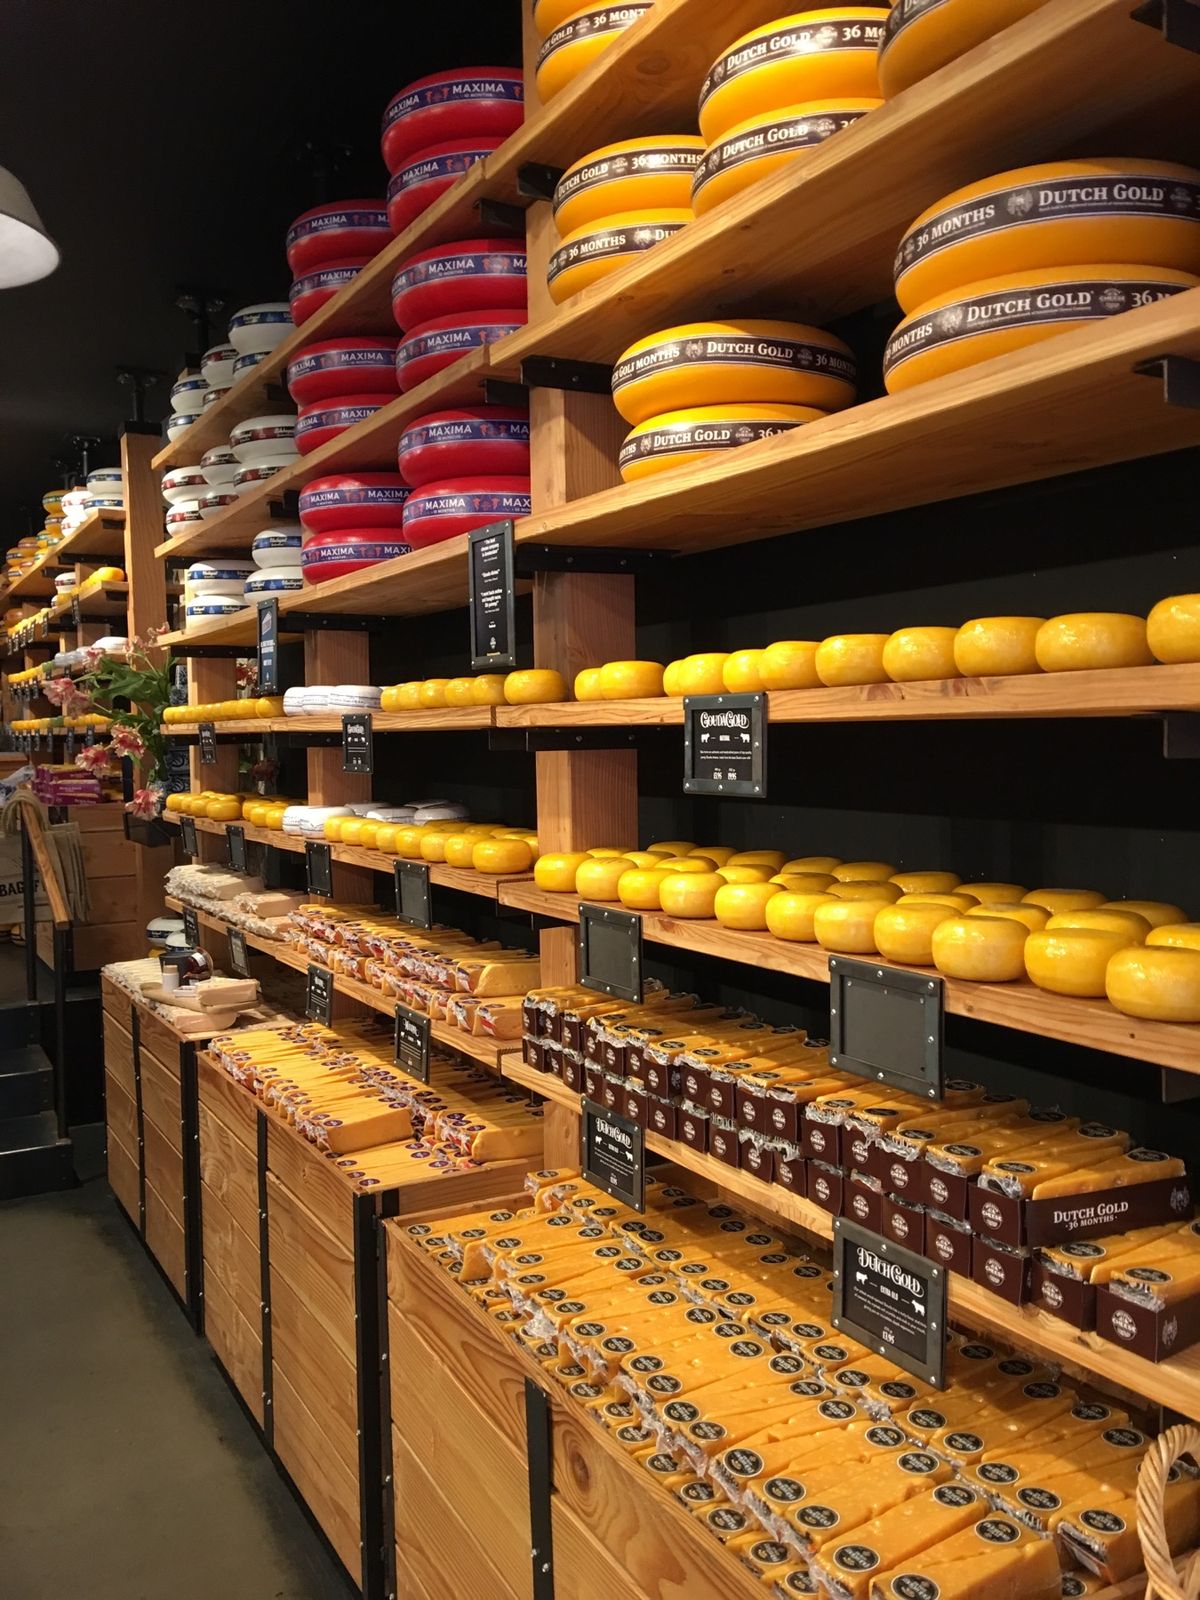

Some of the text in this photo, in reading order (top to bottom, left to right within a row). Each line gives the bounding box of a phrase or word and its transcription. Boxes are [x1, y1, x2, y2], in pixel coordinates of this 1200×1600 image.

[593, 12, 607, 28] 36
[726, 43, 767, 70] DUTCH
[769, 32, 811, 51] GOLD
[841, 25, 860, 41] 36
[388, 82, 505, 117] MAXIMA MAXIMA
[722, 123, 808, 159] DUTCH GOLD
[402, 161, 439, 182] MAXIMA
[558, 174, 580, 197] DUTCH
[582, 163, 608, 181] GOLD
[631, 154, 646, 169] 36
[311, 215, 347, 228] MAXIMA
[917, 183, 1164, 251] 36 MONTHS DUTCH GOLD
[568, 245, 579, 261] 36
[580, 235, 626, 255] MONTHS
[428, 259, 475, 275] MAXIMA
[892, 323, 933, 355] MONTHS
[967, 300, 1032, 323] DUTCH
[1036, 292, 1092, 309] GOLD
[1131, 290, 1153, 308] 36
[427, 332, 471, 347] MAXIMA
[341, 352, 384, 361] MAXIMA
[636, 347, 680, 370] MONTHS
[706, 341, 755, 354] DUTCH
[757, 343, 794, 359] GOLD
[815, 354, 828, 367] 36
[428, 424, 472, 438] MAXIMA
[653, 433, 692, 448] DUTCH
[694, 429, 731, 441] GOLD
[310, 490, 410, 503] MAXIMA MAXIMA
[425, 498, 466, 511] MAXIMA
[320, 546, 414, 557] MAXIMA MAXI
[1053, 1201, 1129, 1224] DUTCH GOLD
[1080, 1215, 1114, 1228] MONTHS
[890, 1264, 924, 1298] GOLD
